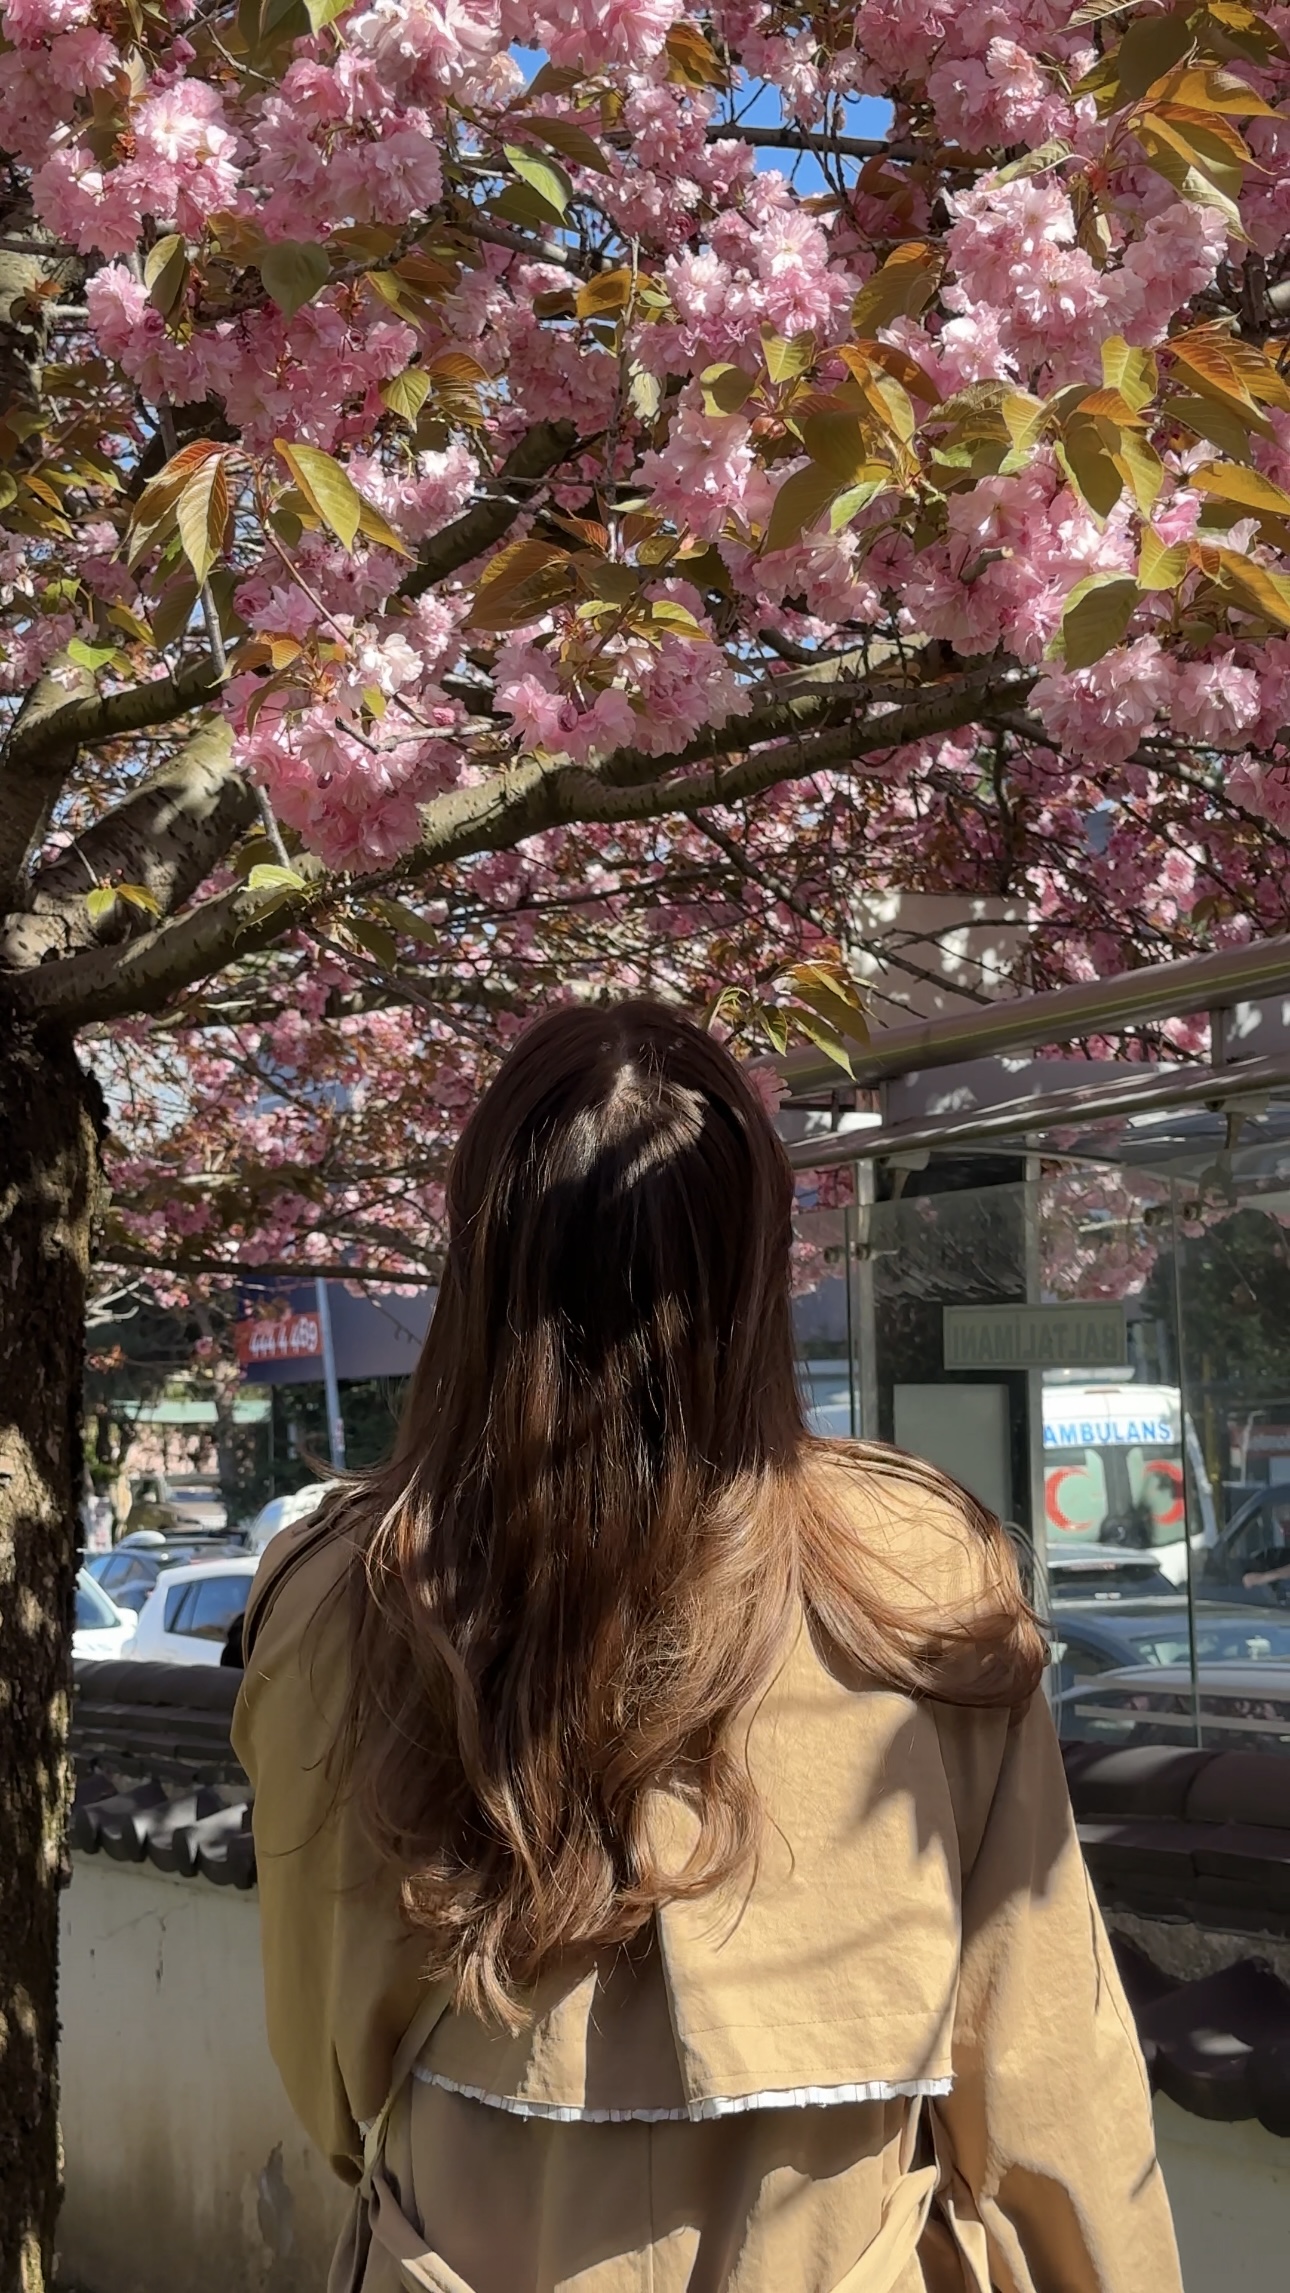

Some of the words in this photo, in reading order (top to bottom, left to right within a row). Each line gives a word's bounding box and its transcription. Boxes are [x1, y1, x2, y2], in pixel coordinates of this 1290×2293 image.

[249, 1329, 276, 1358] 444
[278, 1325, 288, 1355] 4
[1043, 1421, 1172, 1443] AMBULANS
